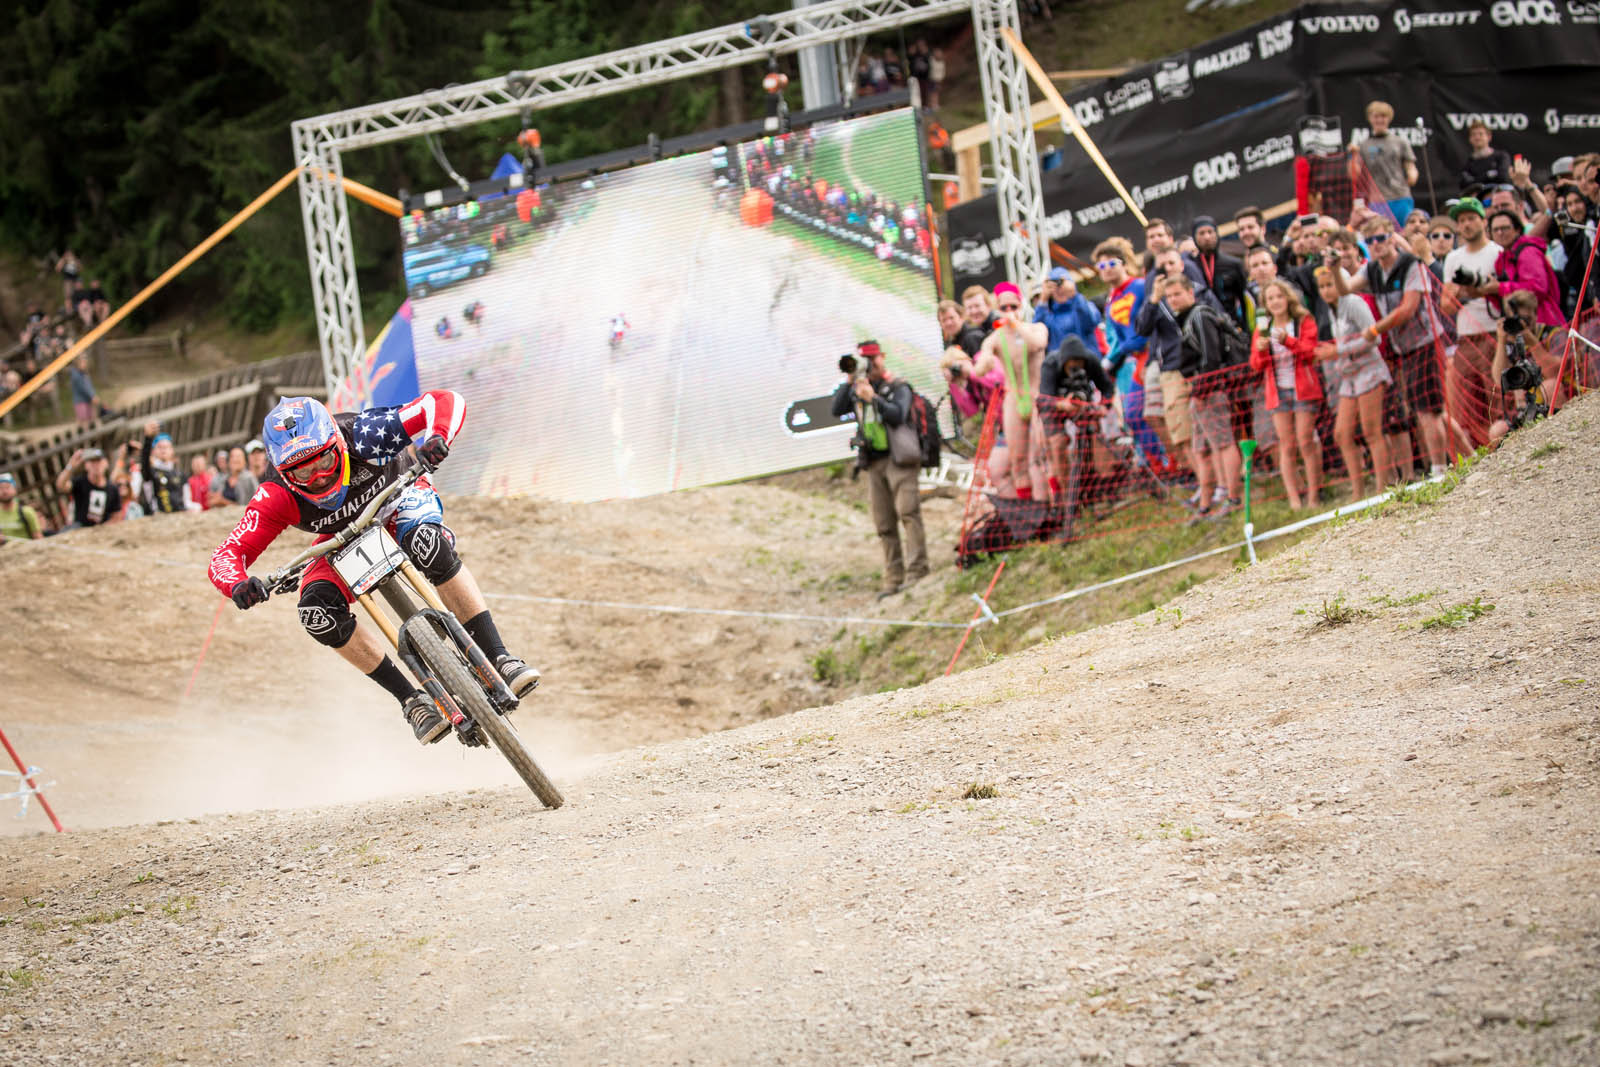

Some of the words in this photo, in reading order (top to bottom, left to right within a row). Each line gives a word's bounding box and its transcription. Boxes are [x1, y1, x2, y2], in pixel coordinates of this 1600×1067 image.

[1302, 14, 1380, 34] VOLVO
[1412, 10, 1482, 27] SCOTT
[1193, 43, 1252, 78] MAXXIS
[1104, 78, 1152, 107] GoPro
[1243, 134, 1293, 162] GoPro
[1143, 175, 1189, 201] SCOTT
[1076, 197, 1126, 227] VOLVO
[310, 474, 386, 533] SPECIALIZED
[355, 545, 374, 566] 1
